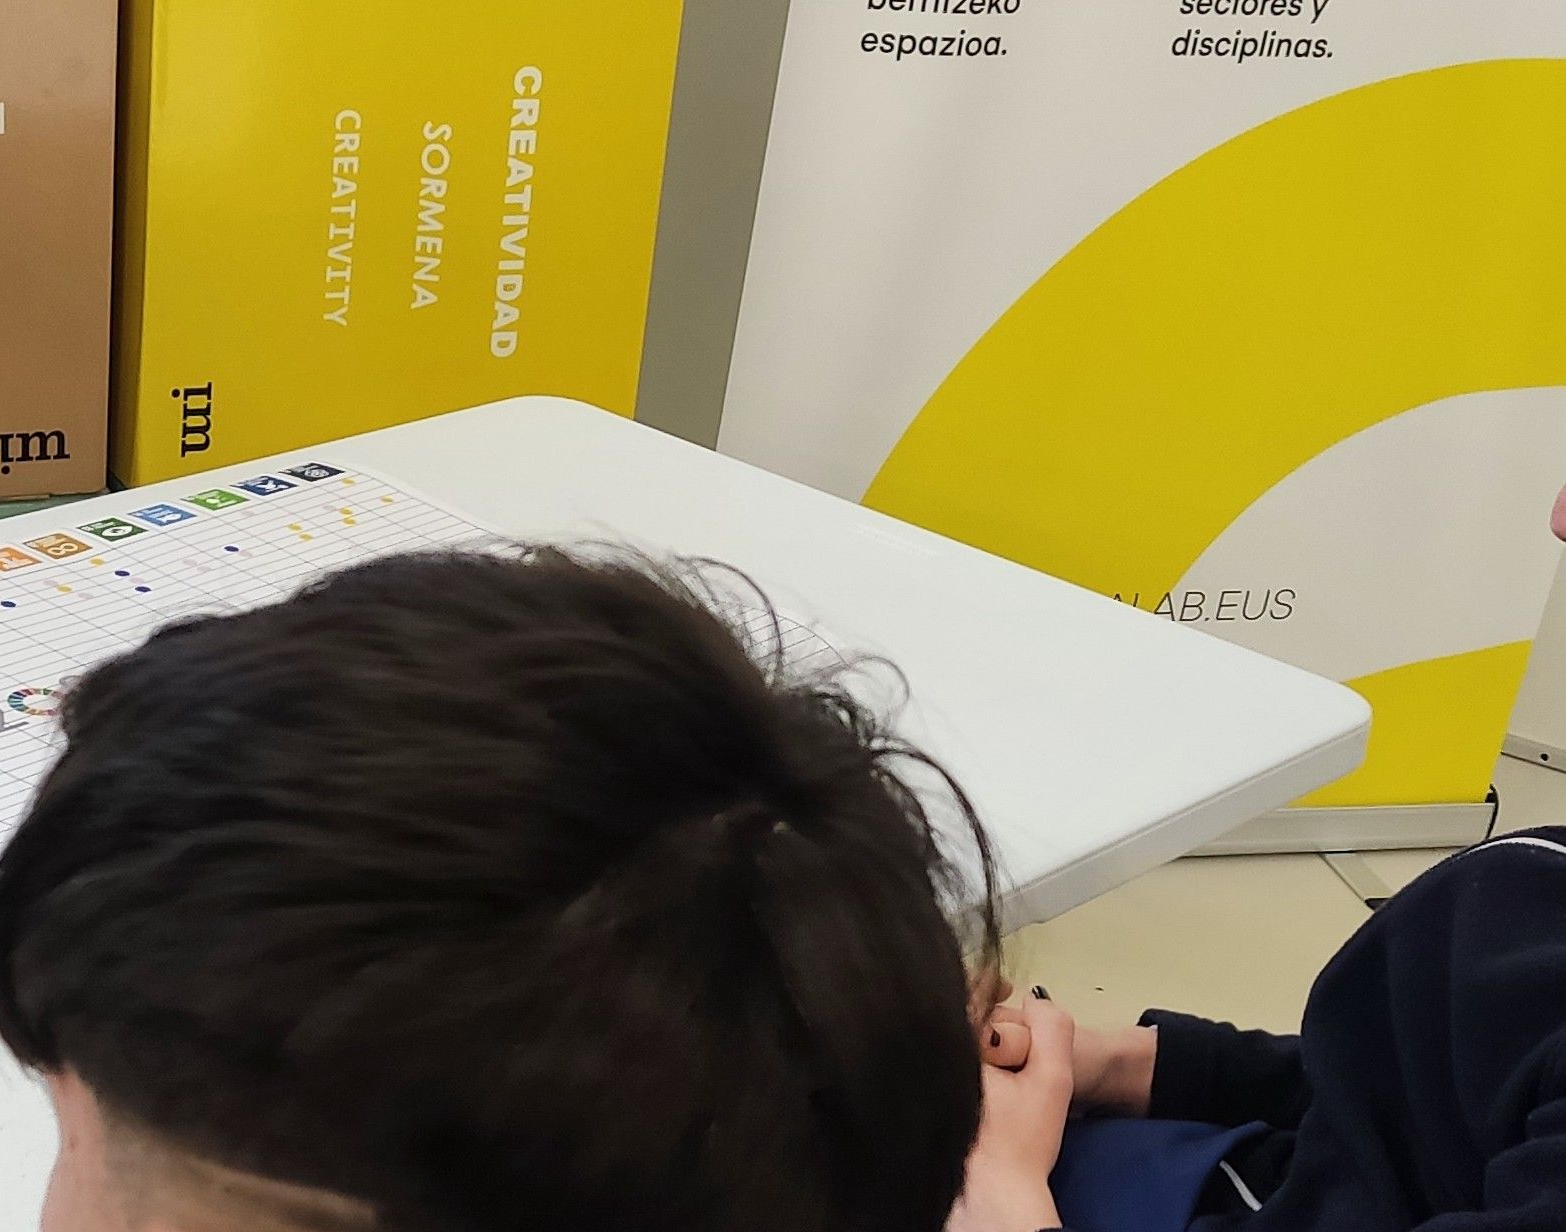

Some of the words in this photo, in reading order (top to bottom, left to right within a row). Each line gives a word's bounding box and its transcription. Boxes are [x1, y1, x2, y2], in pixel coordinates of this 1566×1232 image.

[861, 29, 1008, 61] espazioa.
[1171, 28, 1333, 64] disciplinas.
[1310, 0, 1330, 24] y
[322, 108, 362, 327] CREATIVITY
[410, 120, 453, 311] SORMENA
[488, 65, 543, 359] CREATIVIDAD
